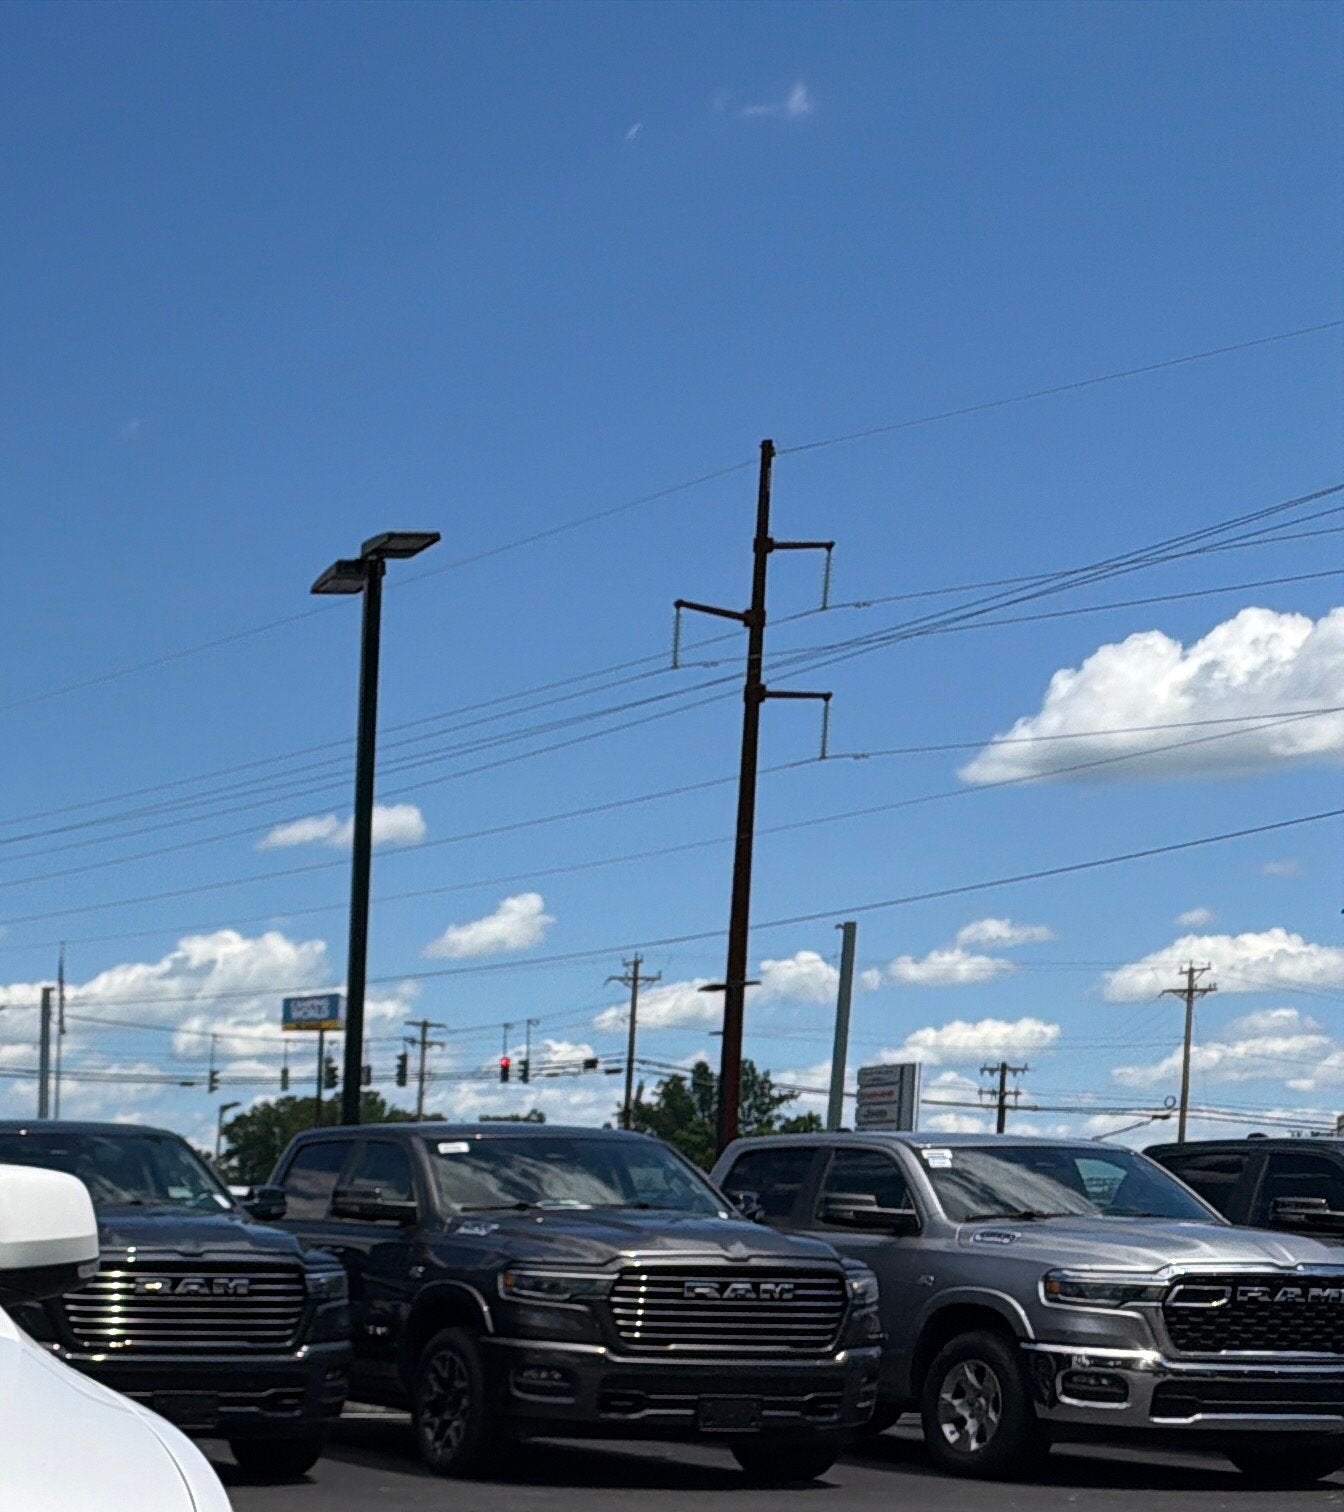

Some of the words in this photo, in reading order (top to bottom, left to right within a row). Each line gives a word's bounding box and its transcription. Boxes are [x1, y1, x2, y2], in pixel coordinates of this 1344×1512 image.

[134, 1278, 249, 1295] RAM
[684, 1282, 794, 1299] RAM
[1237, 1286, 1344, 1303] RAM
